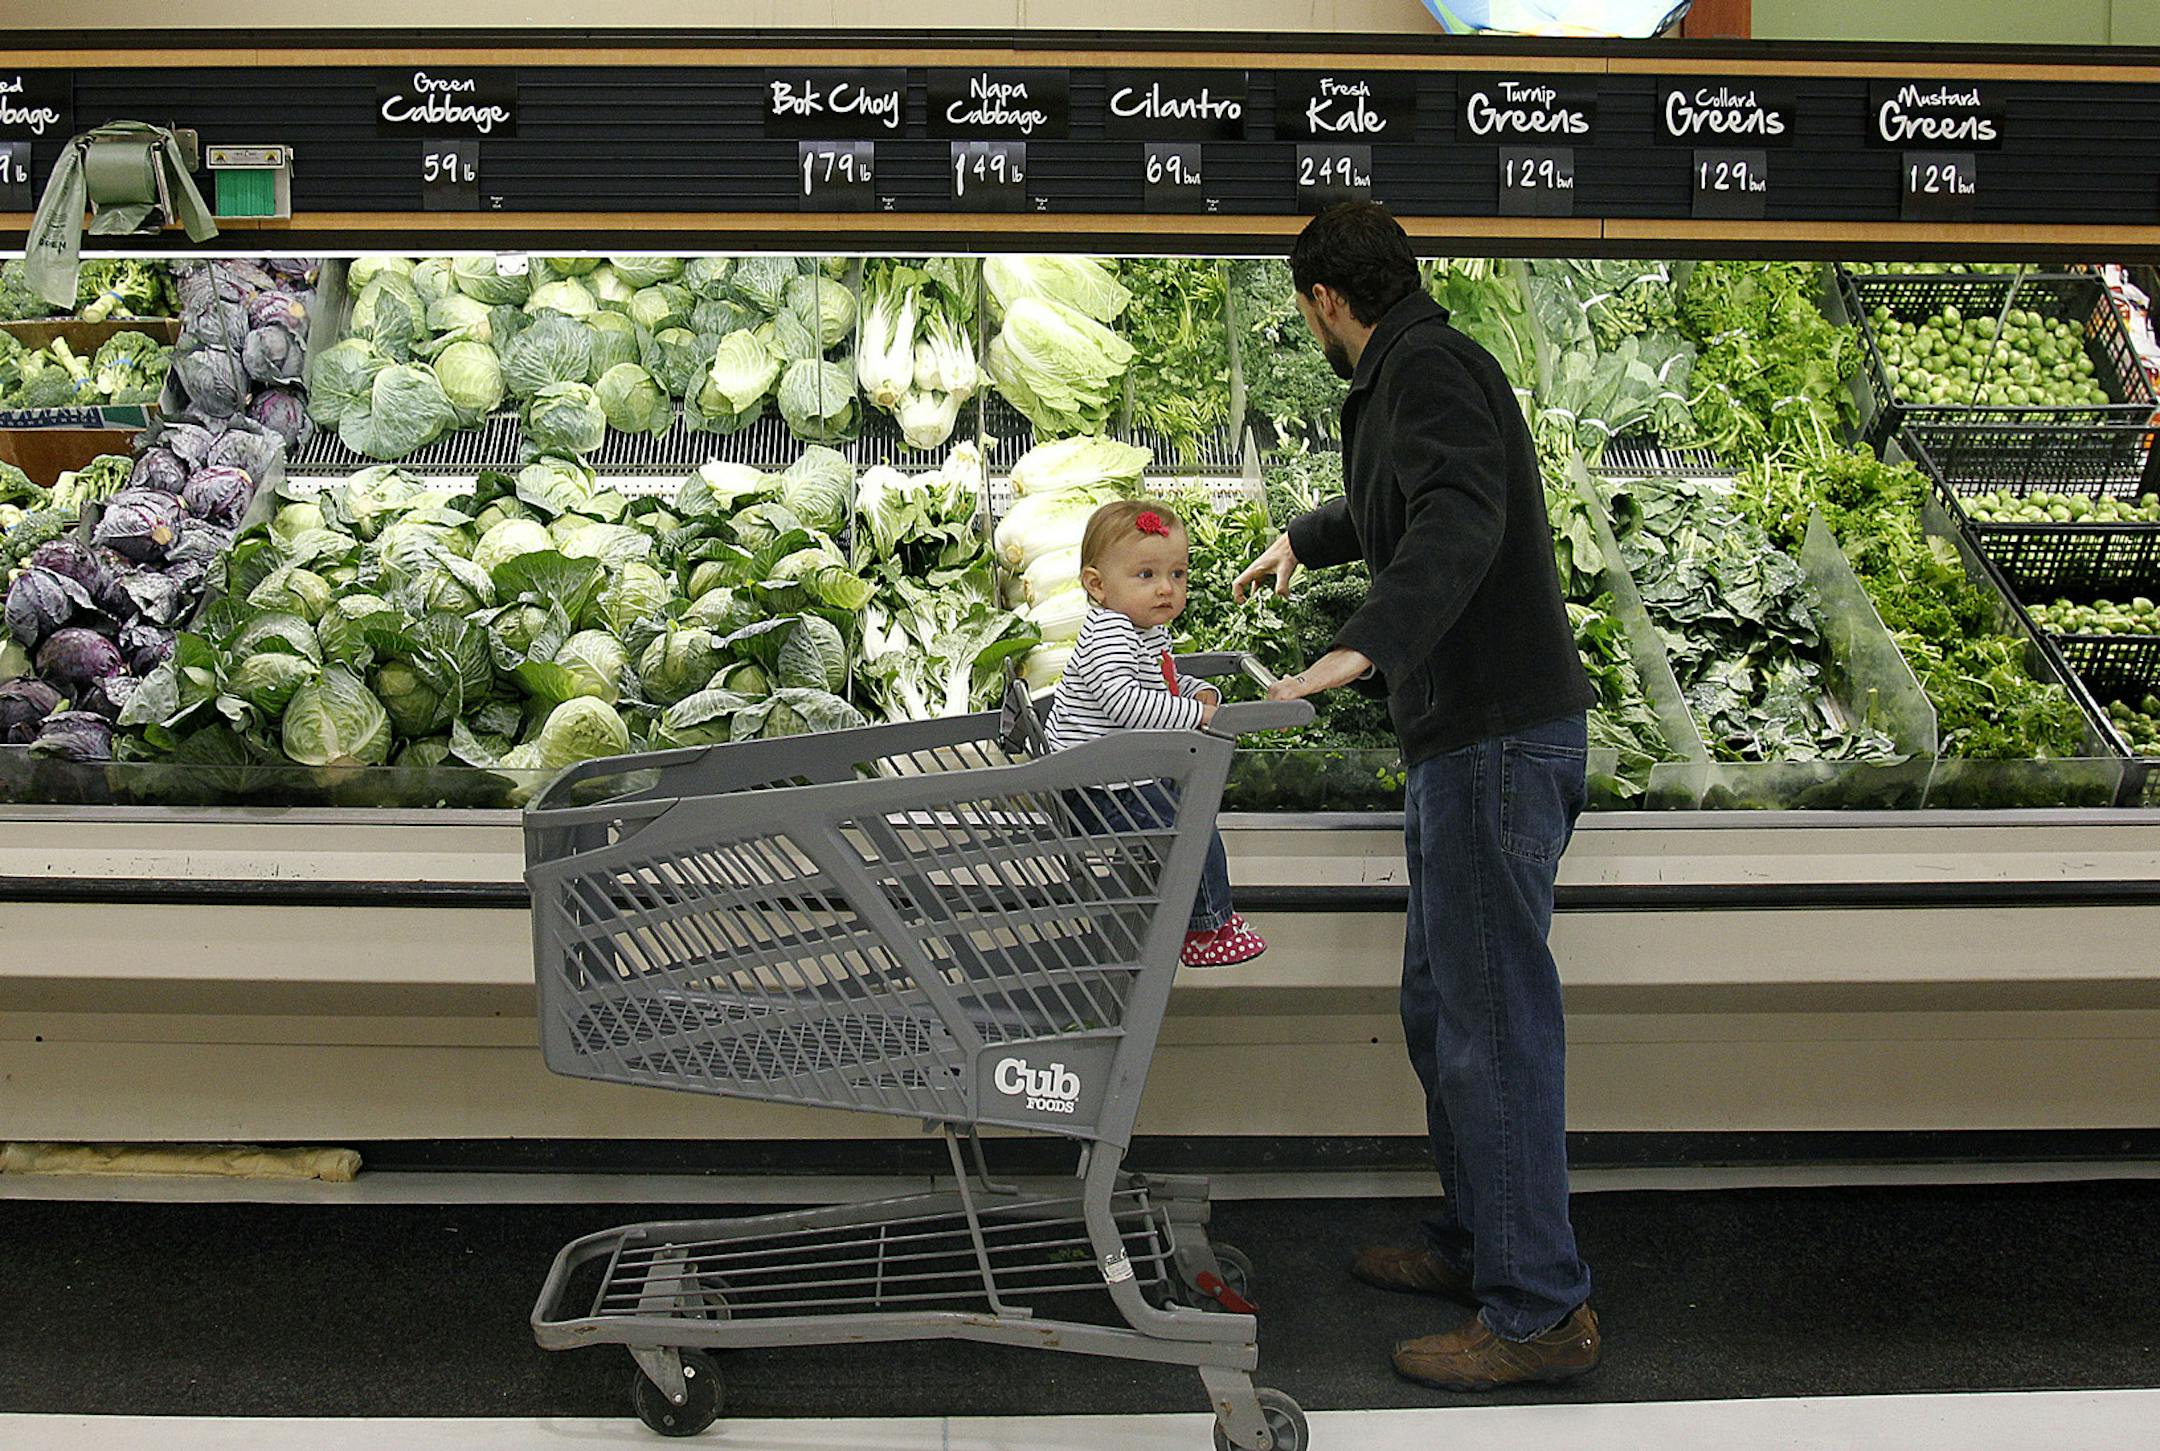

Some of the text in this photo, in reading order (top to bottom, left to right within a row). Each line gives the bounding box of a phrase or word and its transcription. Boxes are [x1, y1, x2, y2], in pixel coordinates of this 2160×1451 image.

[0, 76, 23, 93] ed
[413, 71, 476, 93] Green
[970, 72, 1028, 105] Napa
[1319, 76, 1371, 98] Fresh
[1497, 81, 1557, 109] Turnip
[1695, 86, 1757, 108] Collard
[1897, 85, 1981, 108] Mustard
[0, 95, 60, 136] bage
[381, 94, 510, 134] Cabbage
[770, 79, 900, 129] Bok Choy
[946, 99, 1048, 134] Cabbage
[1109, 82, 1242, 120] Cilantro
[1305, 97, 1388, 134] Kale
[1466, 91, 1590, 136] Greens
[1664, 89, 1785, 138] Greens
[1877, 99, 1998, 143] Greens
[15, 164, 28, 183] lb
[994, 1057, 1081, 1101] Cub
[1025, 1097, 1075, 1114] FOODS
